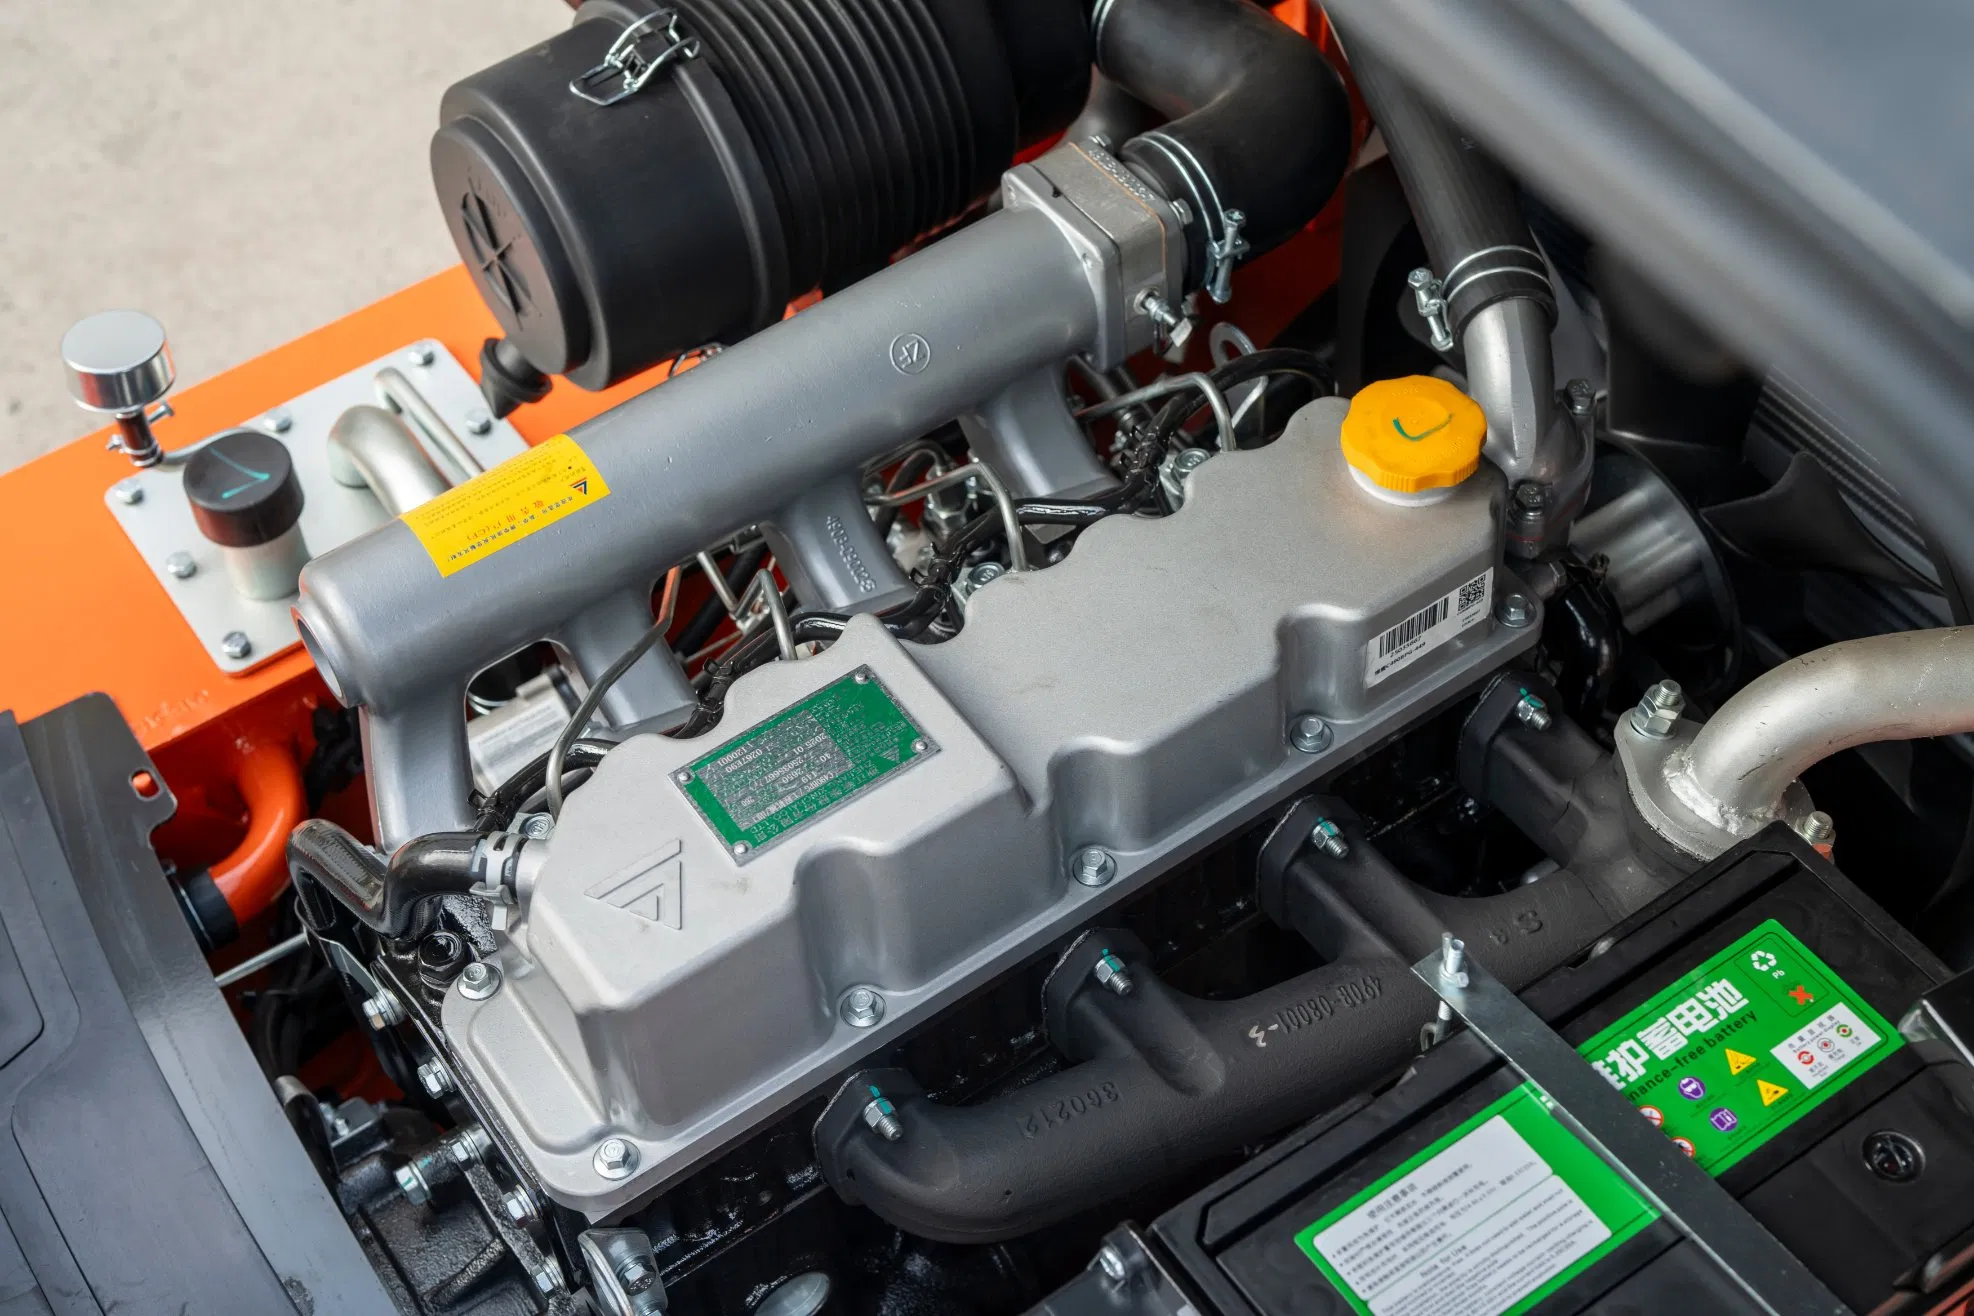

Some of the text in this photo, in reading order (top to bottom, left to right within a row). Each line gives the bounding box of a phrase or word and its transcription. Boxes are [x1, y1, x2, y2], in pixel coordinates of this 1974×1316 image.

[804, 732, 827, 748] 2025
[762, 756, 804, 783] 25035667
[826, 759, 875, 790] ZHEJIANG
[1772, 969, 1785, 980] Pb
[1707, 1009, 1758, 1048] battery
